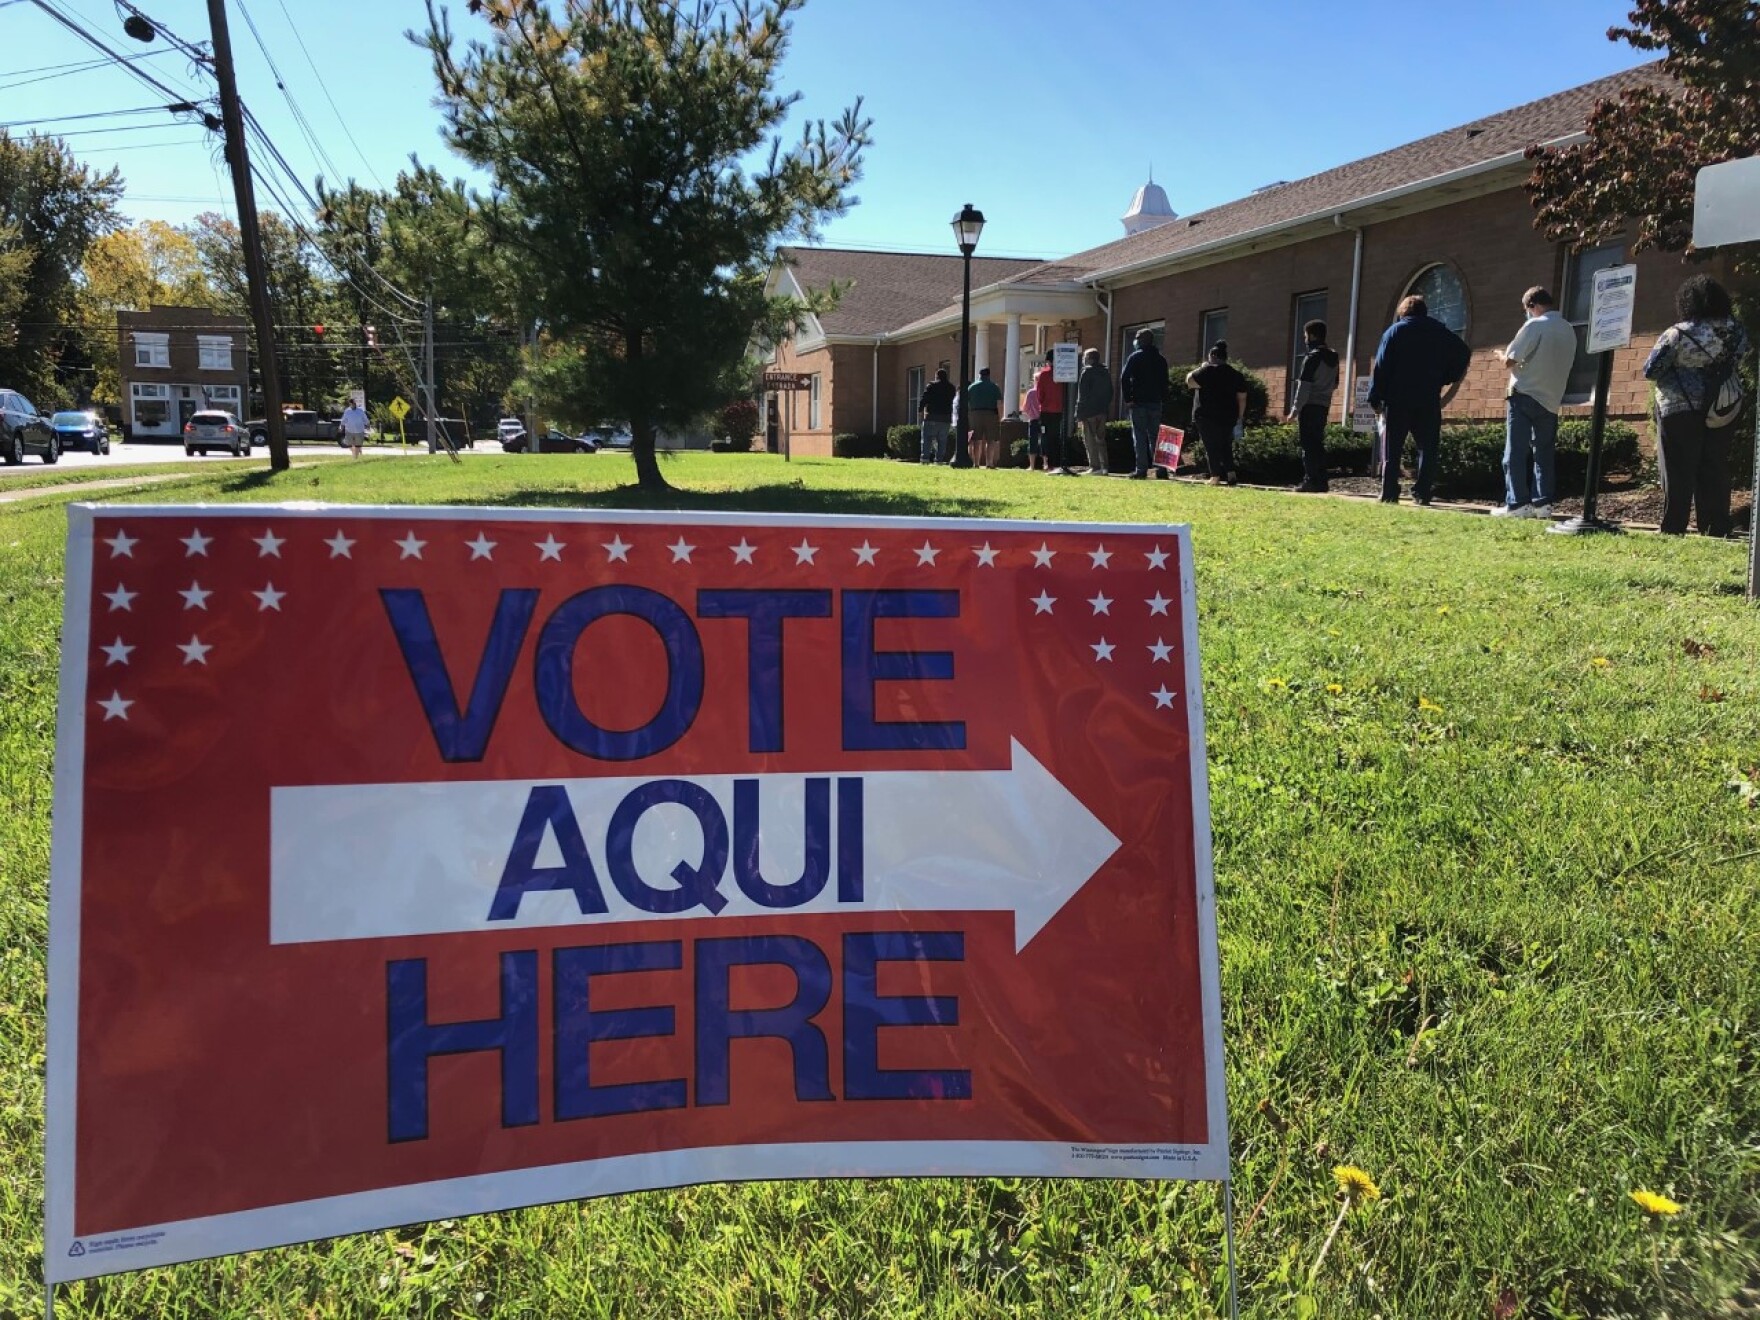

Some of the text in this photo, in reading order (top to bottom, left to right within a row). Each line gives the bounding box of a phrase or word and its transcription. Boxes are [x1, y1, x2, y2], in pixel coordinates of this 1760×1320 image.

[765, 373, 797, 382] ENTRANCE
[378, 583, 967, 763] VOTE
[487, 777, 864, 921] AQUI
[386, 931, 972, 1144] HERE
